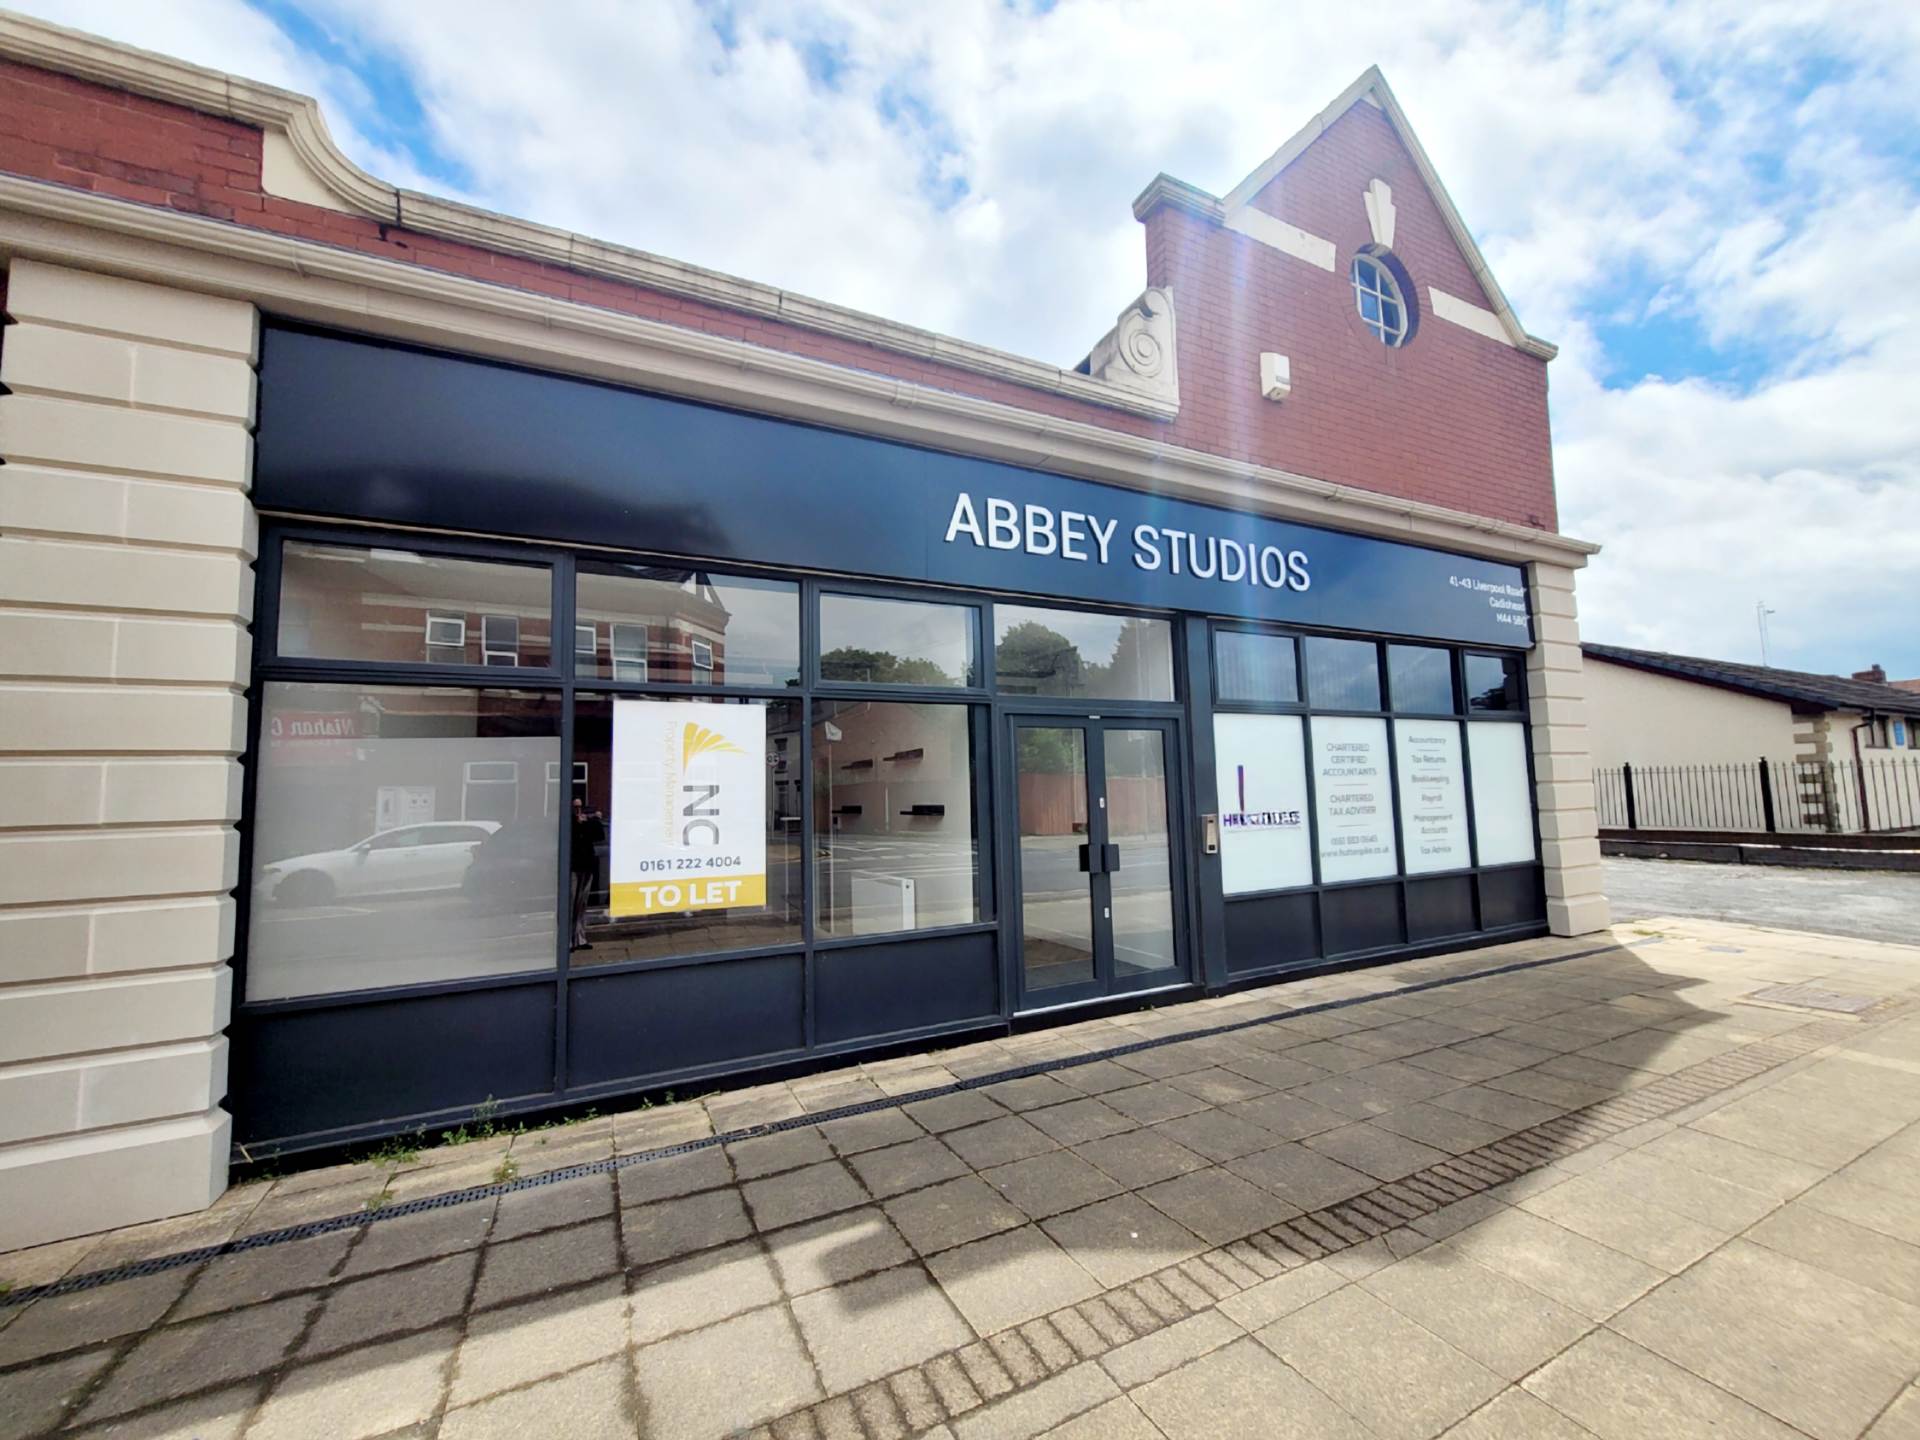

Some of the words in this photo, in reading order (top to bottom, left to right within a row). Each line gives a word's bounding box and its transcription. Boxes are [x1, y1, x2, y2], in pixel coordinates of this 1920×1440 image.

[945, 492, 1118, 564] ABBEY
[1133, 524, 1311, 592] STUDIOS
[1326, 742, 1370, 752] CHARTERED
[1330, 755, 1368, 764] CERTIFIED
[1322, 767, 1377, 776] ACCOUNTANTS
[1329, 793, 1374, 803] CHARTERED
[683, 785, 720, 846] NC
[1328, 807, 1344, 816] TAX
[640, 859, 672, 872] 0161
[677, 858, 702, 869] 222
[706, 856, 742, 868] 4004
[639, 884, 682, 909] TO
[689, 880, 743, 905] LET
